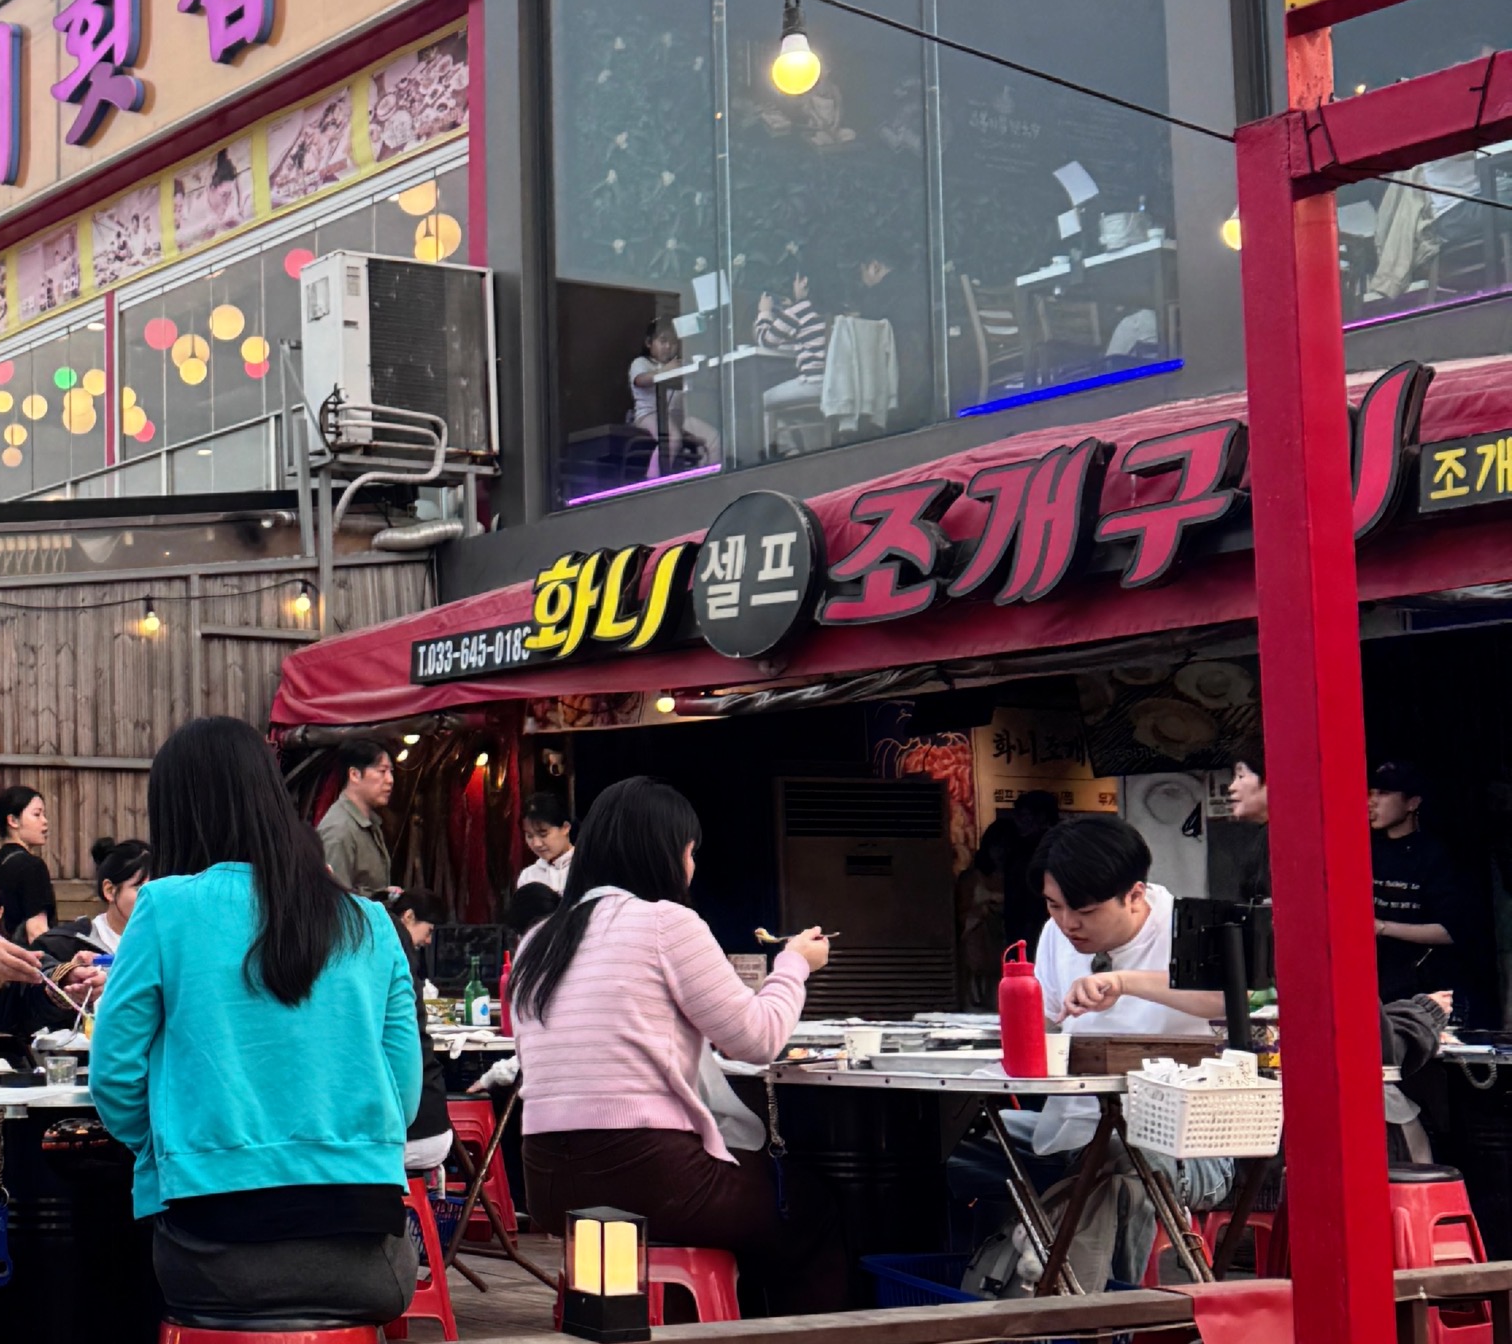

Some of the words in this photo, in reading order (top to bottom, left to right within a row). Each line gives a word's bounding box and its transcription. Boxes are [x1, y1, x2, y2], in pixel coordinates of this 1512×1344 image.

[1429, 436, 1512, 500] 조개
[523, 545, 684, 657] 화니
[699, 529, 800, 621] 셀프
